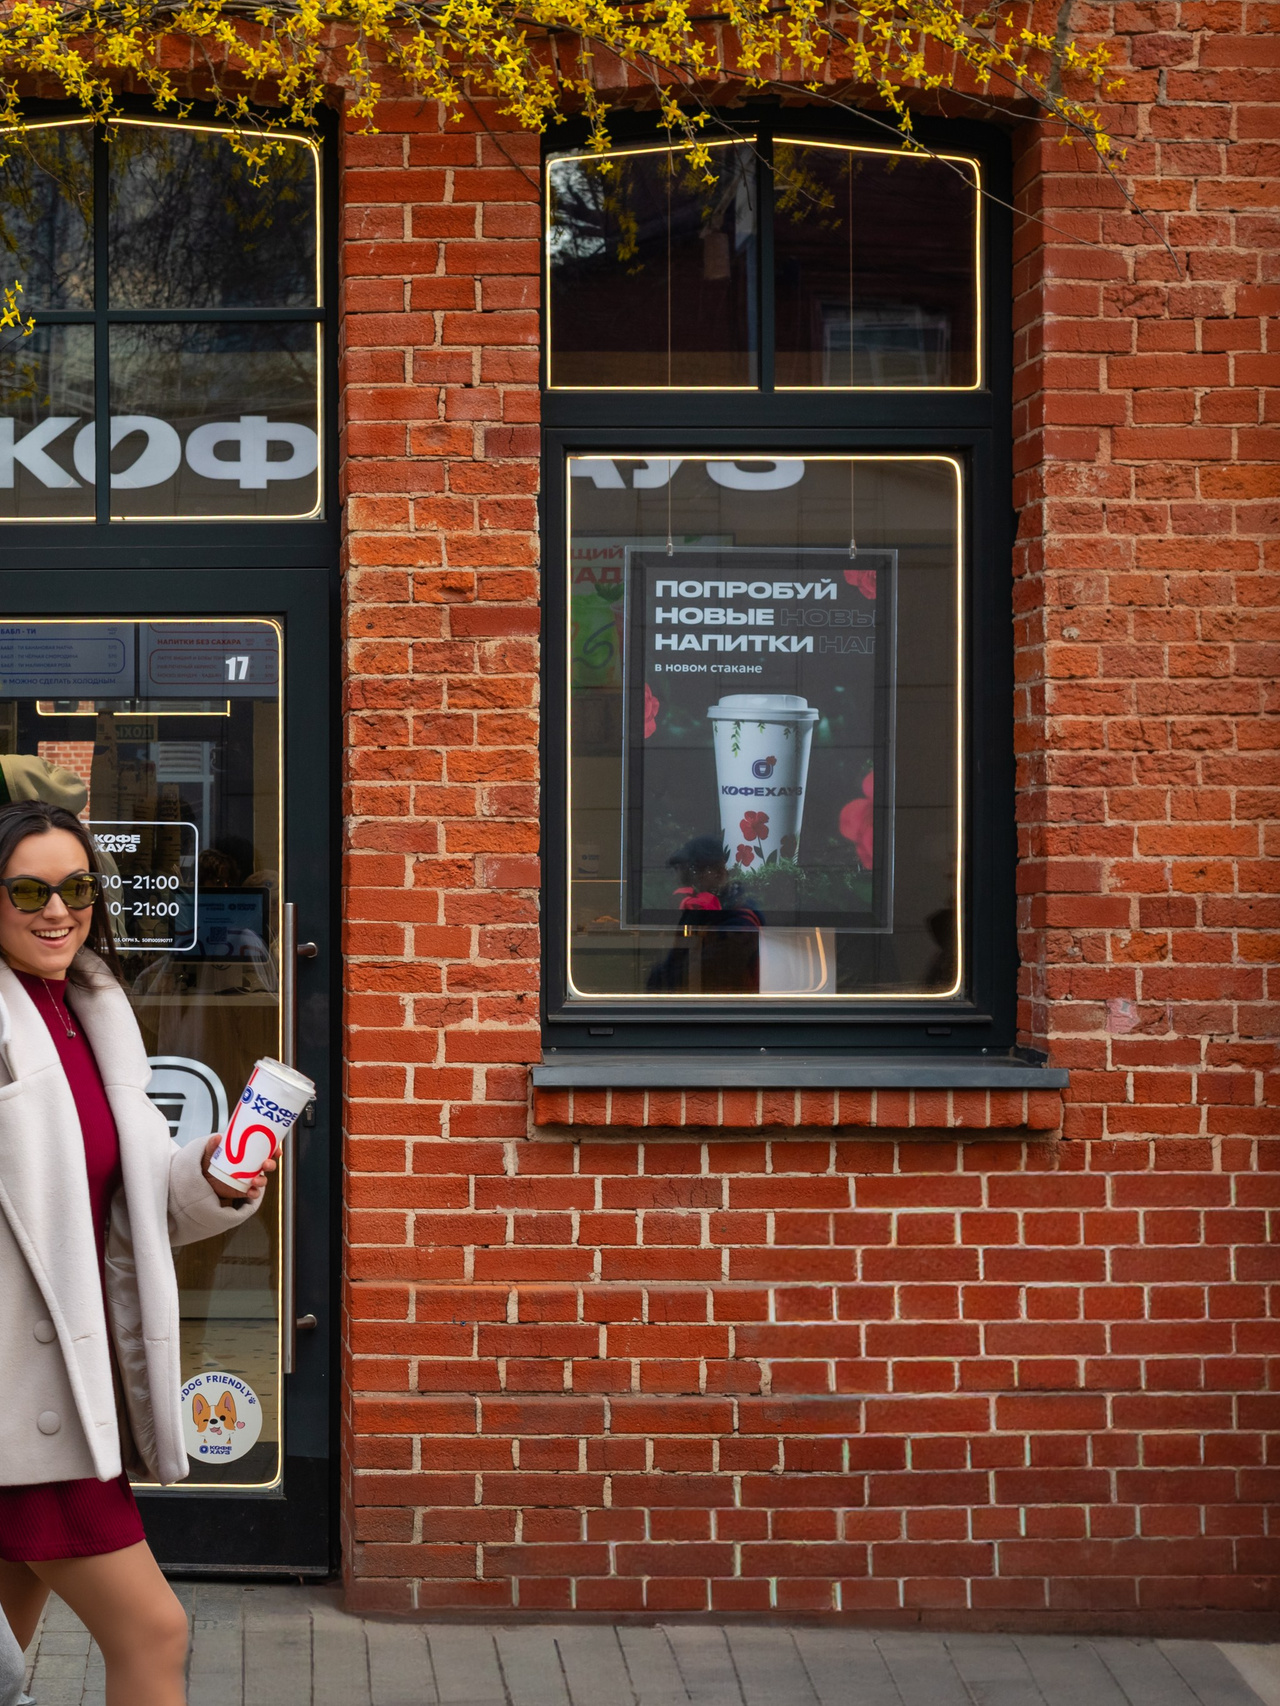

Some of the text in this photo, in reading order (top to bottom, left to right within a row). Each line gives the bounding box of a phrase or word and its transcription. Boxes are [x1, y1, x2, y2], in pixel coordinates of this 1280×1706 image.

[655, 578, 837, 600] ПОПРОБУЙ
[655, 607, 774, 625] НОВЫЕ
[655, 633, 813, 652] НАПИТКИ
[225, 656, 249, 681] 17
[654, 664, 763, 674] в новом стакане
[721, 785, 803, 796] КОФЕХАУЗ
[94, 834, 141, 843] КОФЕ
[251, 1102, 292, 1128] ХАУЗ
[255, 1094, 298, 1121] КОФЕ
[182, 1374, 252, 1397] DOG FRIENDLY
